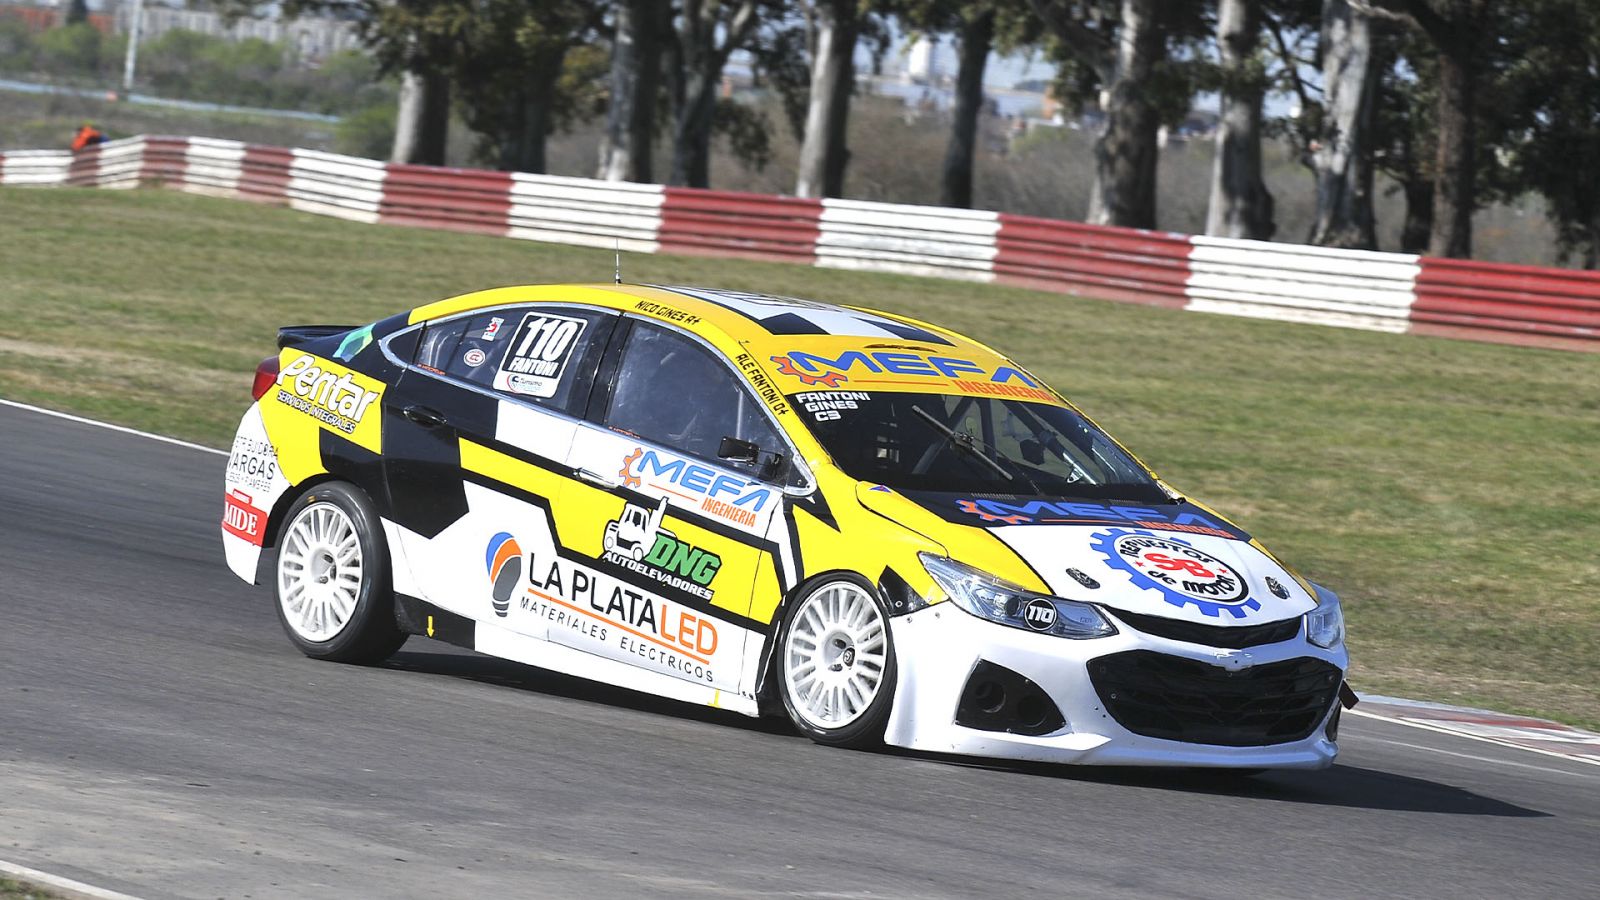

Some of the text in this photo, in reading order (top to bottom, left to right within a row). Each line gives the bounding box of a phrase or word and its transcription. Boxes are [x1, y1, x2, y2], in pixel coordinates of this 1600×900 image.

[635, 301, 656, 313] NICO
[658, 307, 685, 321] GINES
[515, 317, 578, 361] 110
[507, 356, 559, 377] FANTONI
[735, 354, 749, 371] ALE
[747, 368, 782, 405] FANTONI
[787, 351, 1039, 389] MEFA
[276, 354, 380, 423] Pentar
[796, 391, 871, 404] FANTONI
[951, 379, 1058, 402] INGENIERIA
[277, 389, 357, 434] SERVICIOS INTEGRALES
[804, 400, 859, 412] GINES
[815, 411, 842, 421] C3
[637, 450, 771, 513] MEFA
[701, 497, 757, 527] INGENIERIA
[974, 500, 1222, 529] MEFA
[643, 533, 721, 585] DNG
[1119, 538, 1215, 564] REPUESTOS
[1144, 553, 1216, 578] SB
[528, 552, 564, 597] LA
[602, 551, 714, 601] AUTOELEVADORES
[1147, 570, 1177, 585] de
[1027, 605, 1056, 624] 110
[520, 596, 715, 683] MATERIALES ELECTRICOS
